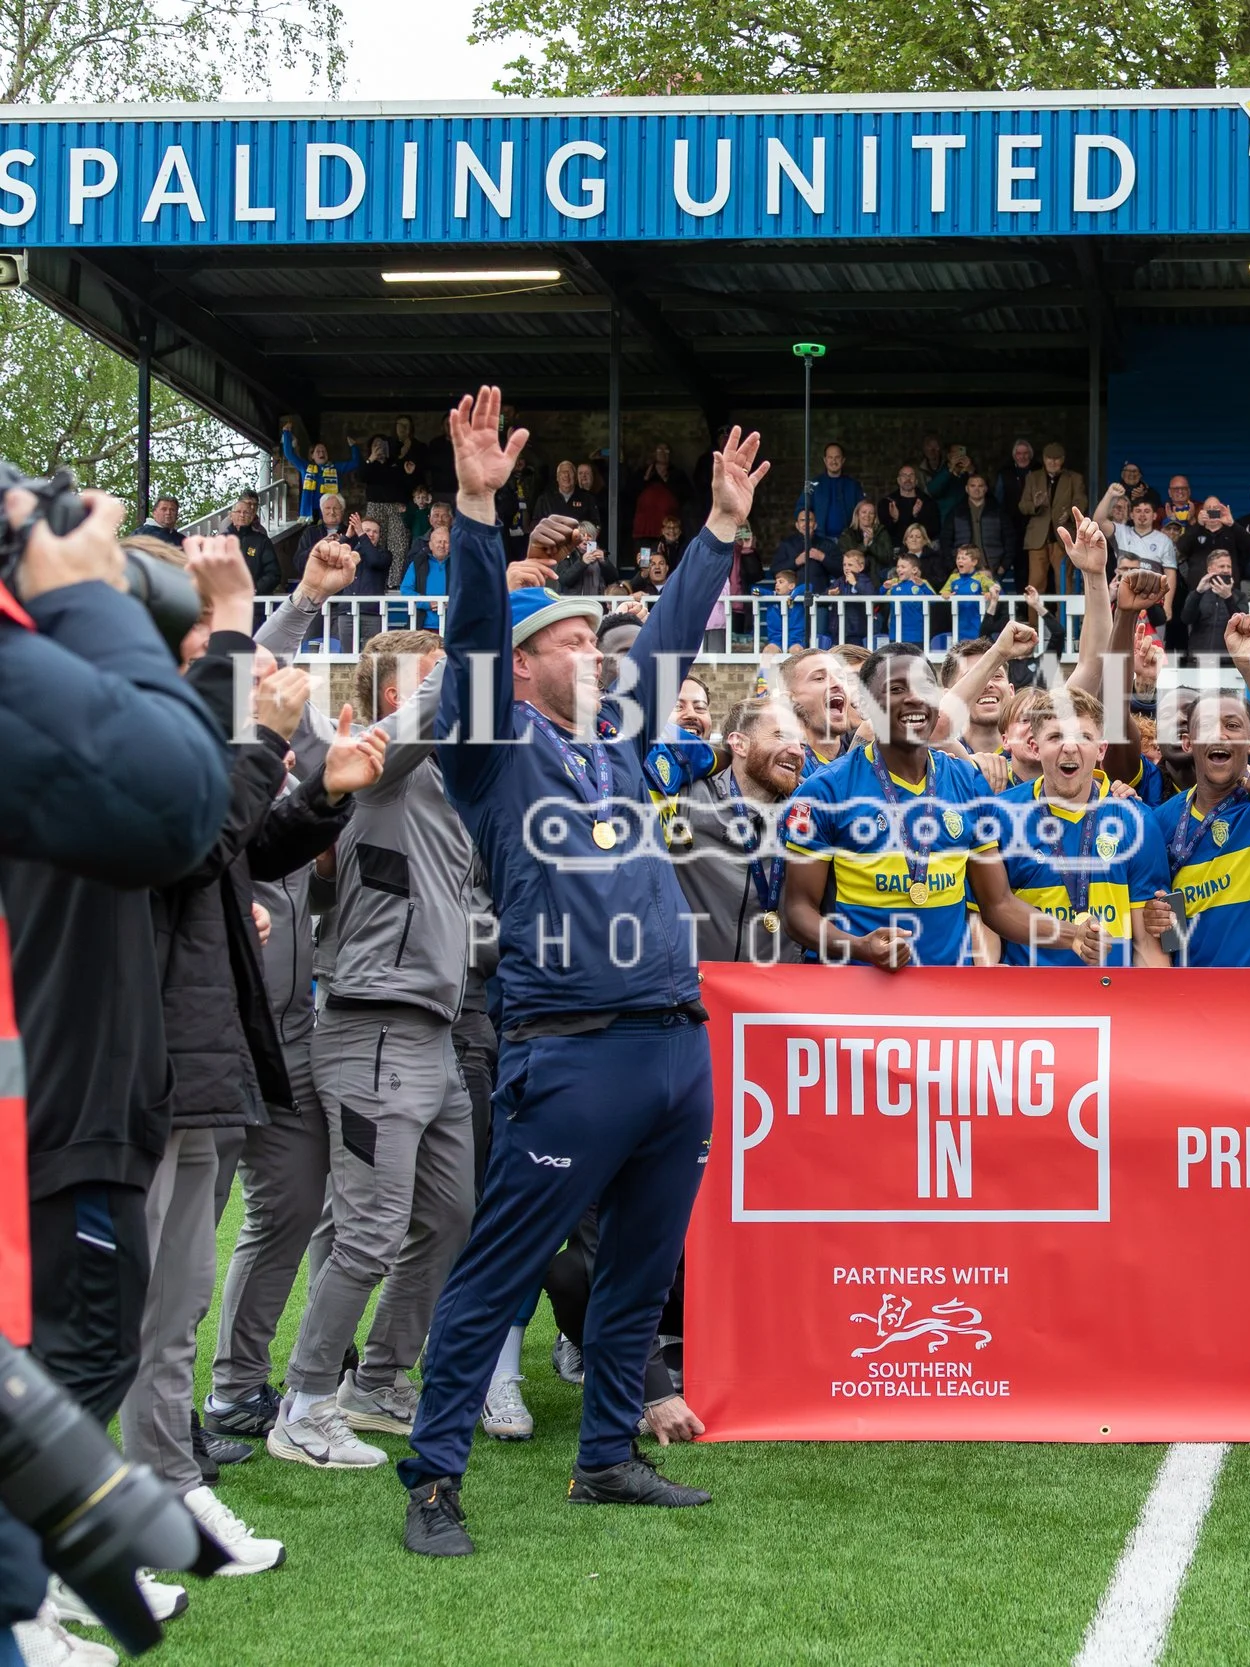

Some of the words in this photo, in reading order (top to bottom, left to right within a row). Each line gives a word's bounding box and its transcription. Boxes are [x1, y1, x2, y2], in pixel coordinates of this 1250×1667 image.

[0, 140, 607, 227] SPALDING
[673, 133, 1136, 217] UNITED
[1033, 904, 1116, 923] ADRNO
[787, 1038, 1055, 1117] PITCHING
[528, 1151, 572, 1168] VX3
[917, 1120, 972, 1198] IN
[833, 1267, 946, 1285] PARTNERS
[952, 1267, 1009, 1285] WITH
[868, 1362, 972, 1378] SOUTHERN
[831, 1381, 932, 1397] FOOTBALL
[936, 1380, 1010, 1397] LEAGUE
